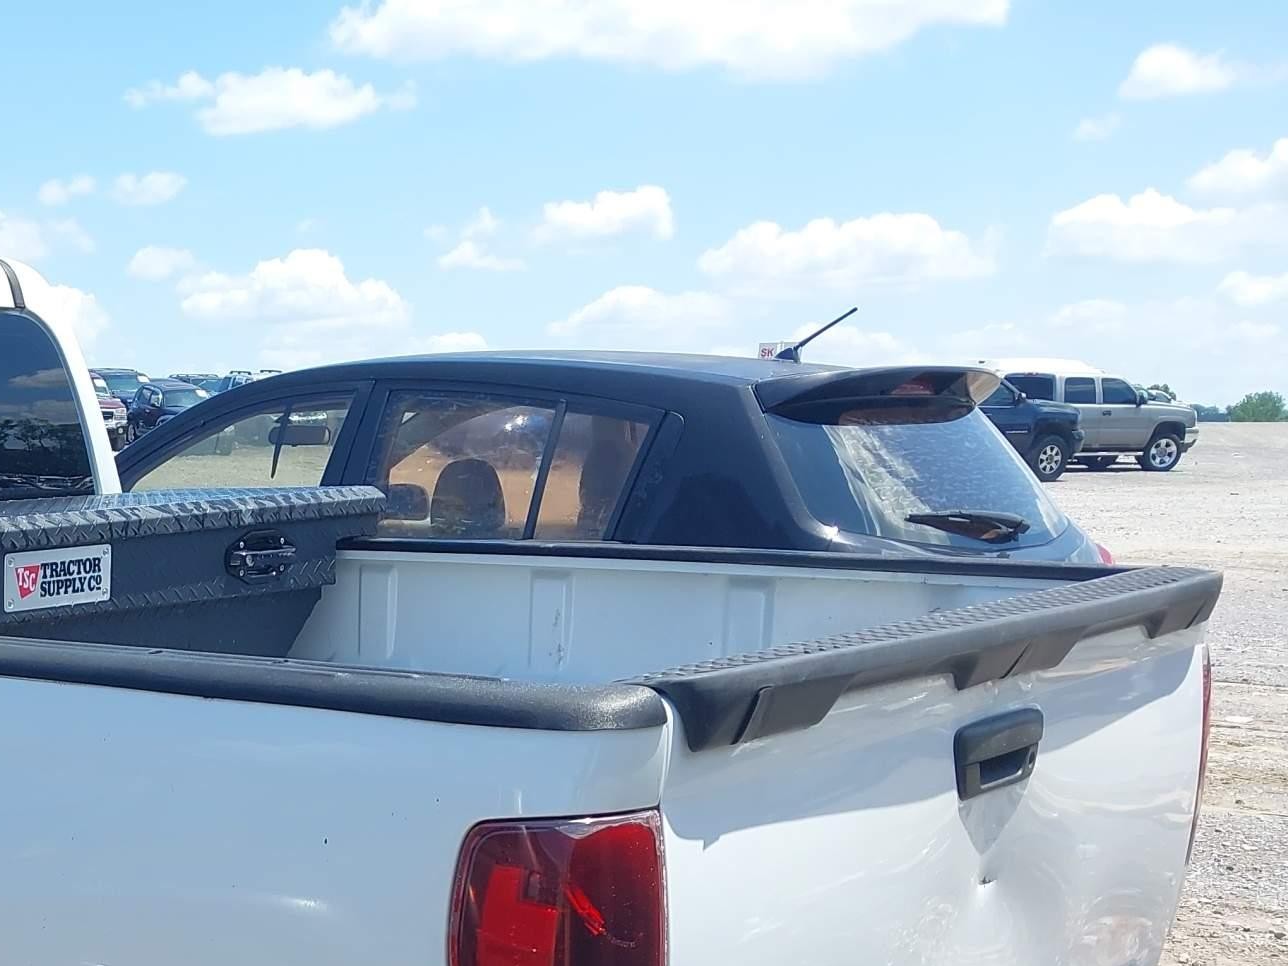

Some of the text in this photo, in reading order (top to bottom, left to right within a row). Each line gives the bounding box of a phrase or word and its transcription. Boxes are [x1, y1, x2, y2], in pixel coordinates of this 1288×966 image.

[41, 557, 101, 578] TRACTOR
[17, 568, 36, 592] TSC
[40, 577, 87, 597] SUPPLY
